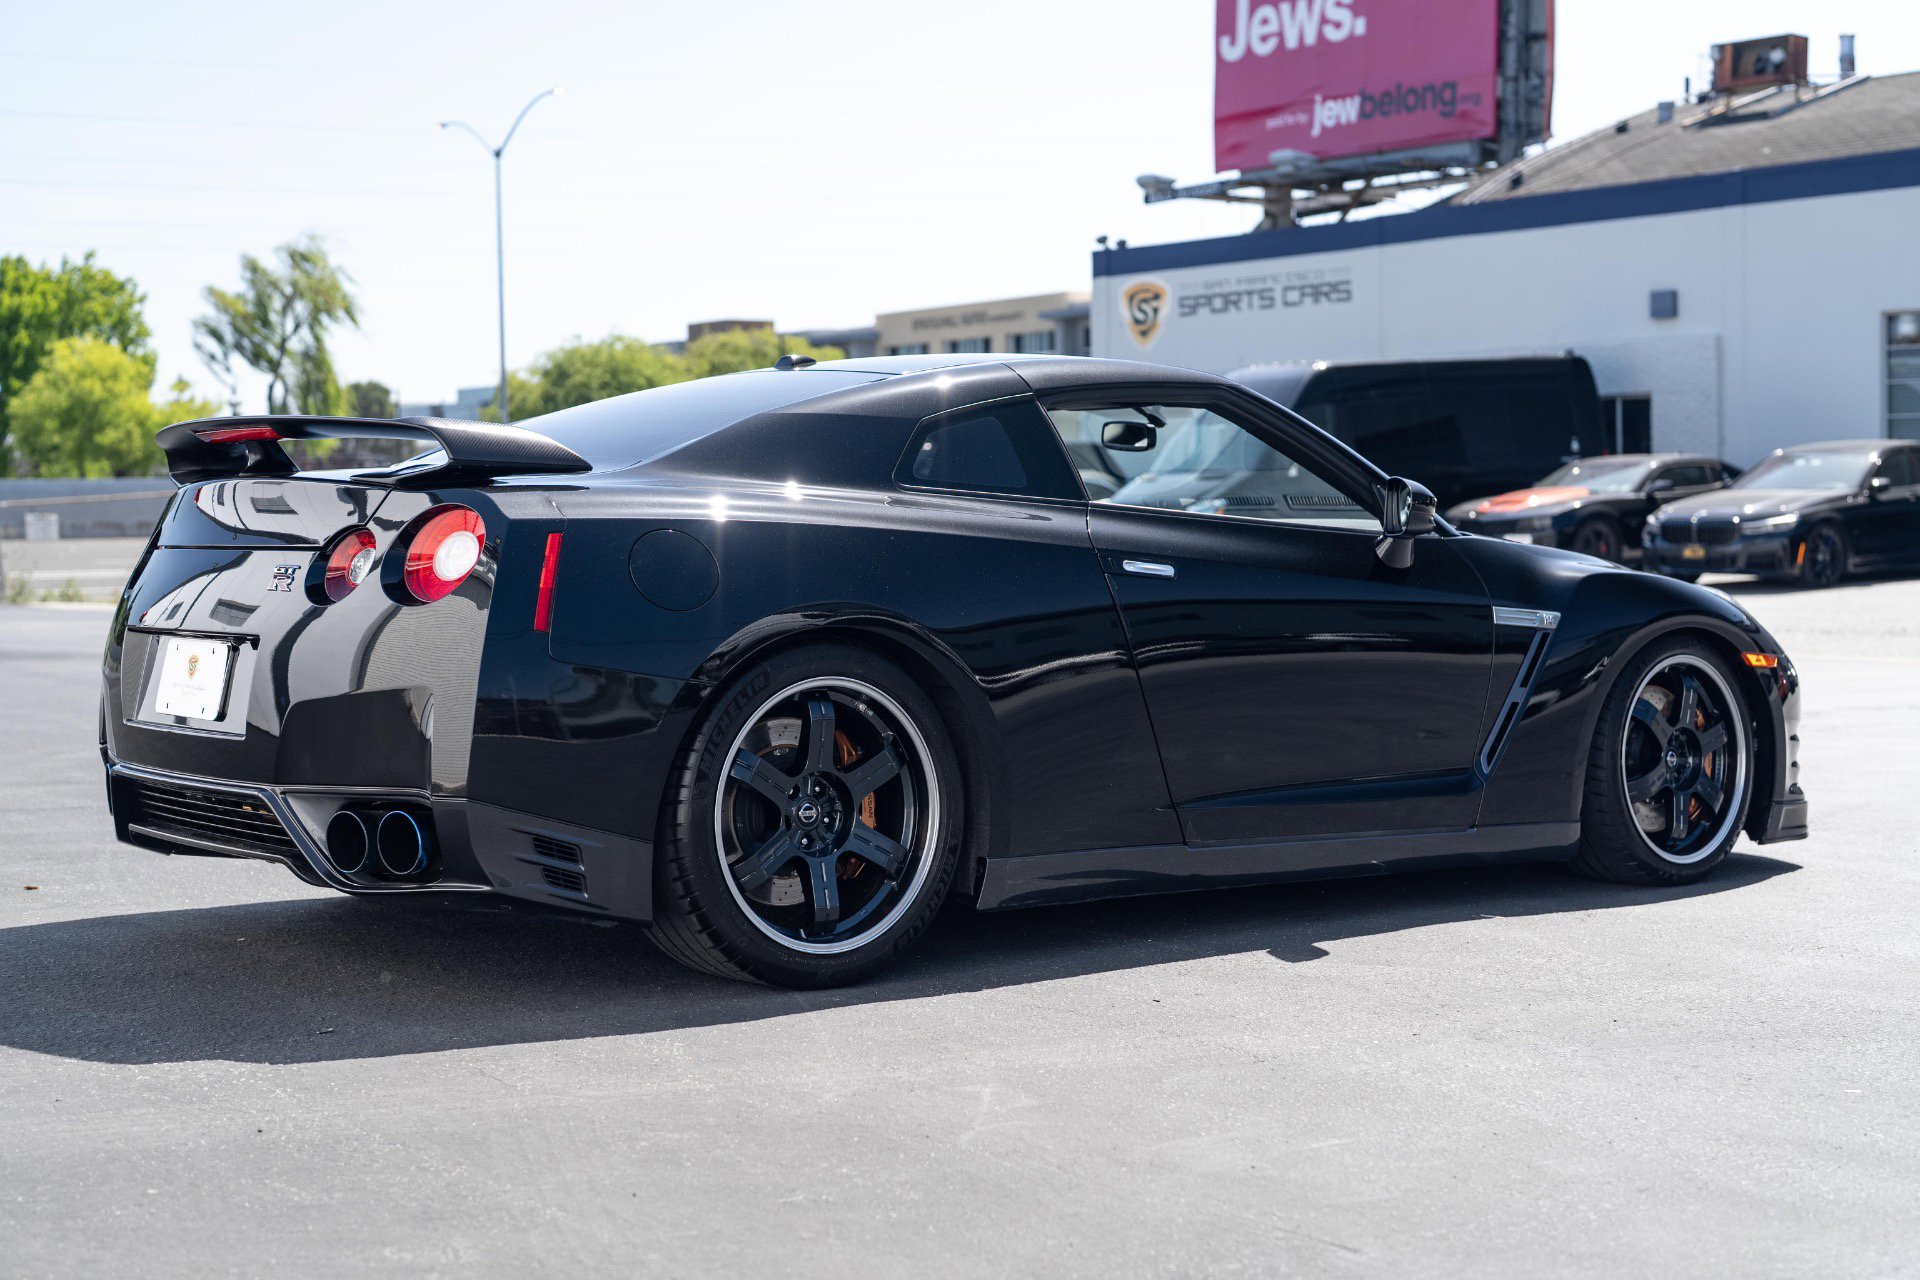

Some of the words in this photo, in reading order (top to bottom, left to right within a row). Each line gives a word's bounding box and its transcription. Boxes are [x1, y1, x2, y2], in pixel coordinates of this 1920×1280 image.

[1218, 0, 1367, 63] Jews.
[1177, 287, 1275, 318] SPORTS
[1281, 280, 1353, 308] CARS
